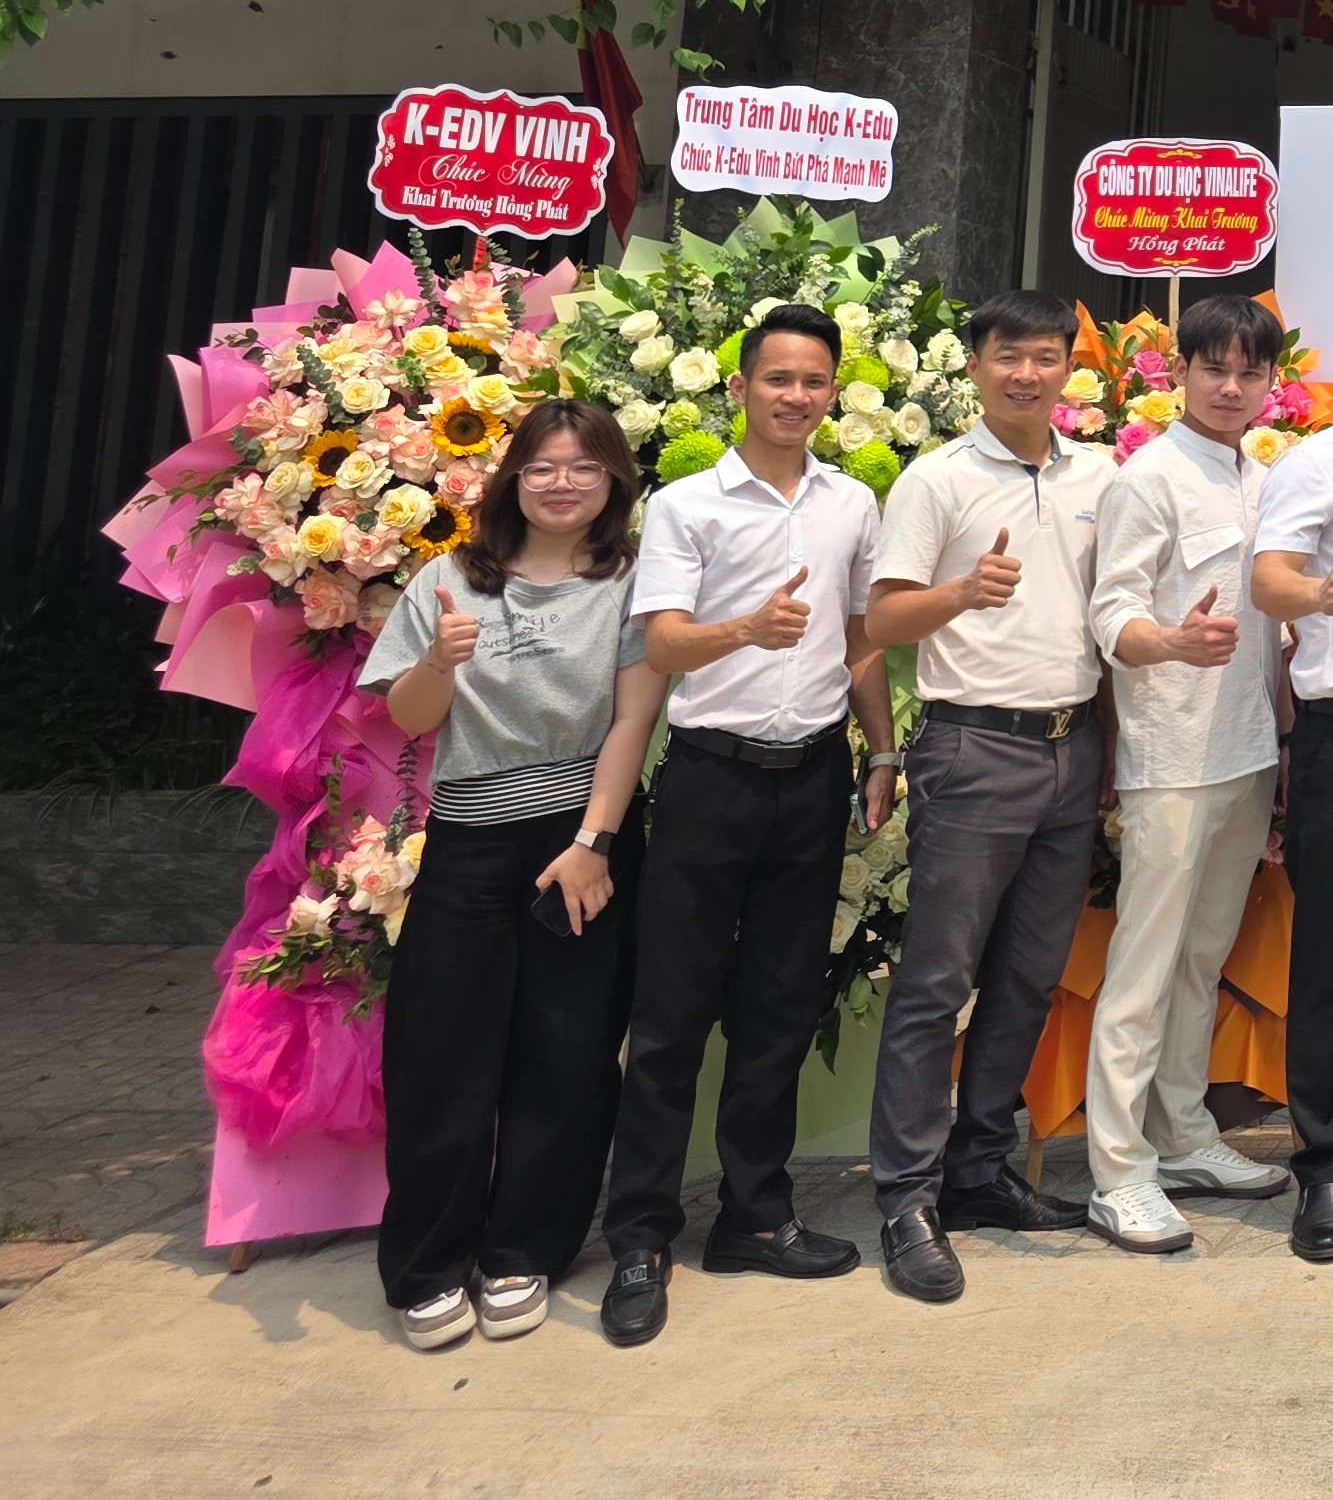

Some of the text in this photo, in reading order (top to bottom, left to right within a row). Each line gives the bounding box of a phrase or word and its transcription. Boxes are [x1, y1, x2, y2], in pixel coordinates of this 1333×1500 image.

[403, 101, 591, 164] K-EDV VINH
[685, 92, 894, 142] Trung Tâm Du Học K-Edu
[418, 154, 573, 200] Chúc Mừng
[680, 142, 712, 173] Chúc
[714, 145, 753, 176] K-Edu
[755, 148, 781, 179] Vinh
[806, 153, 829, 183] Phá
[832, 156, 866, 191] Mạnh
[1099, 159, 1258, 204] CÔNG TY DU HỌC VINALIFE
[401, 185, 437, 208] Khai
[535, 200, 570, 221] Phát
[1094, 205, 1128, 228] Chúc
[1129, 206, 1170, 233] Mừng
[1172, 206, 1208, 229] Khai
[1127, 234, 1226, 255] Hồng Phát
